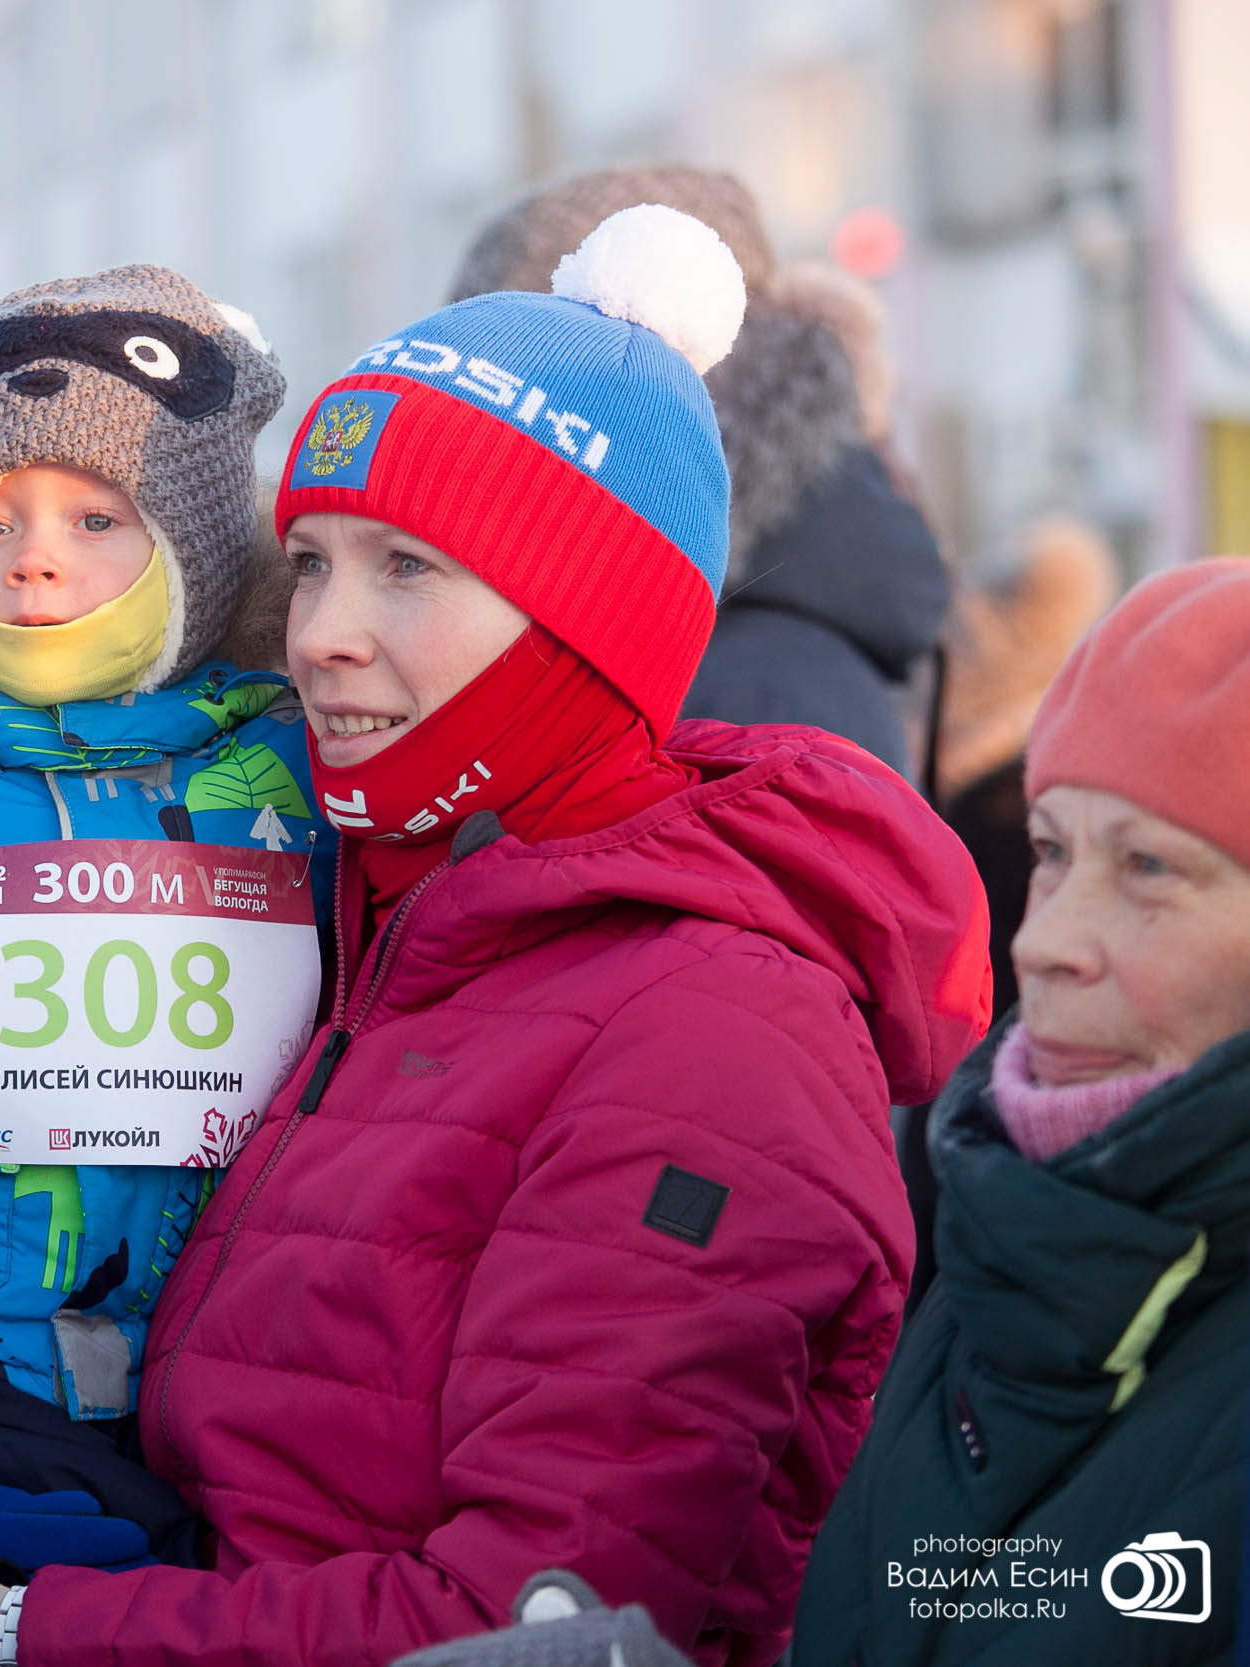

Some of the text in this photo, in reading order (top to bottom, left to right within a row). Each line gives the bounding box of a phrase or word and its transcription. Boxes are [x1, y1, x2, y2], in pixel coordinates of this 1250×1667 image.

[32, 861, 135, 904] 300
[214, 878, 267, 896] БЕГУЩАЯ
[214, 895, 269, 913] ВОЛОГДА
[97, 1068, 243, 1093] СИНЮШКИН
[72, 1126, 161, 1148] ЛУКОЙЛ
